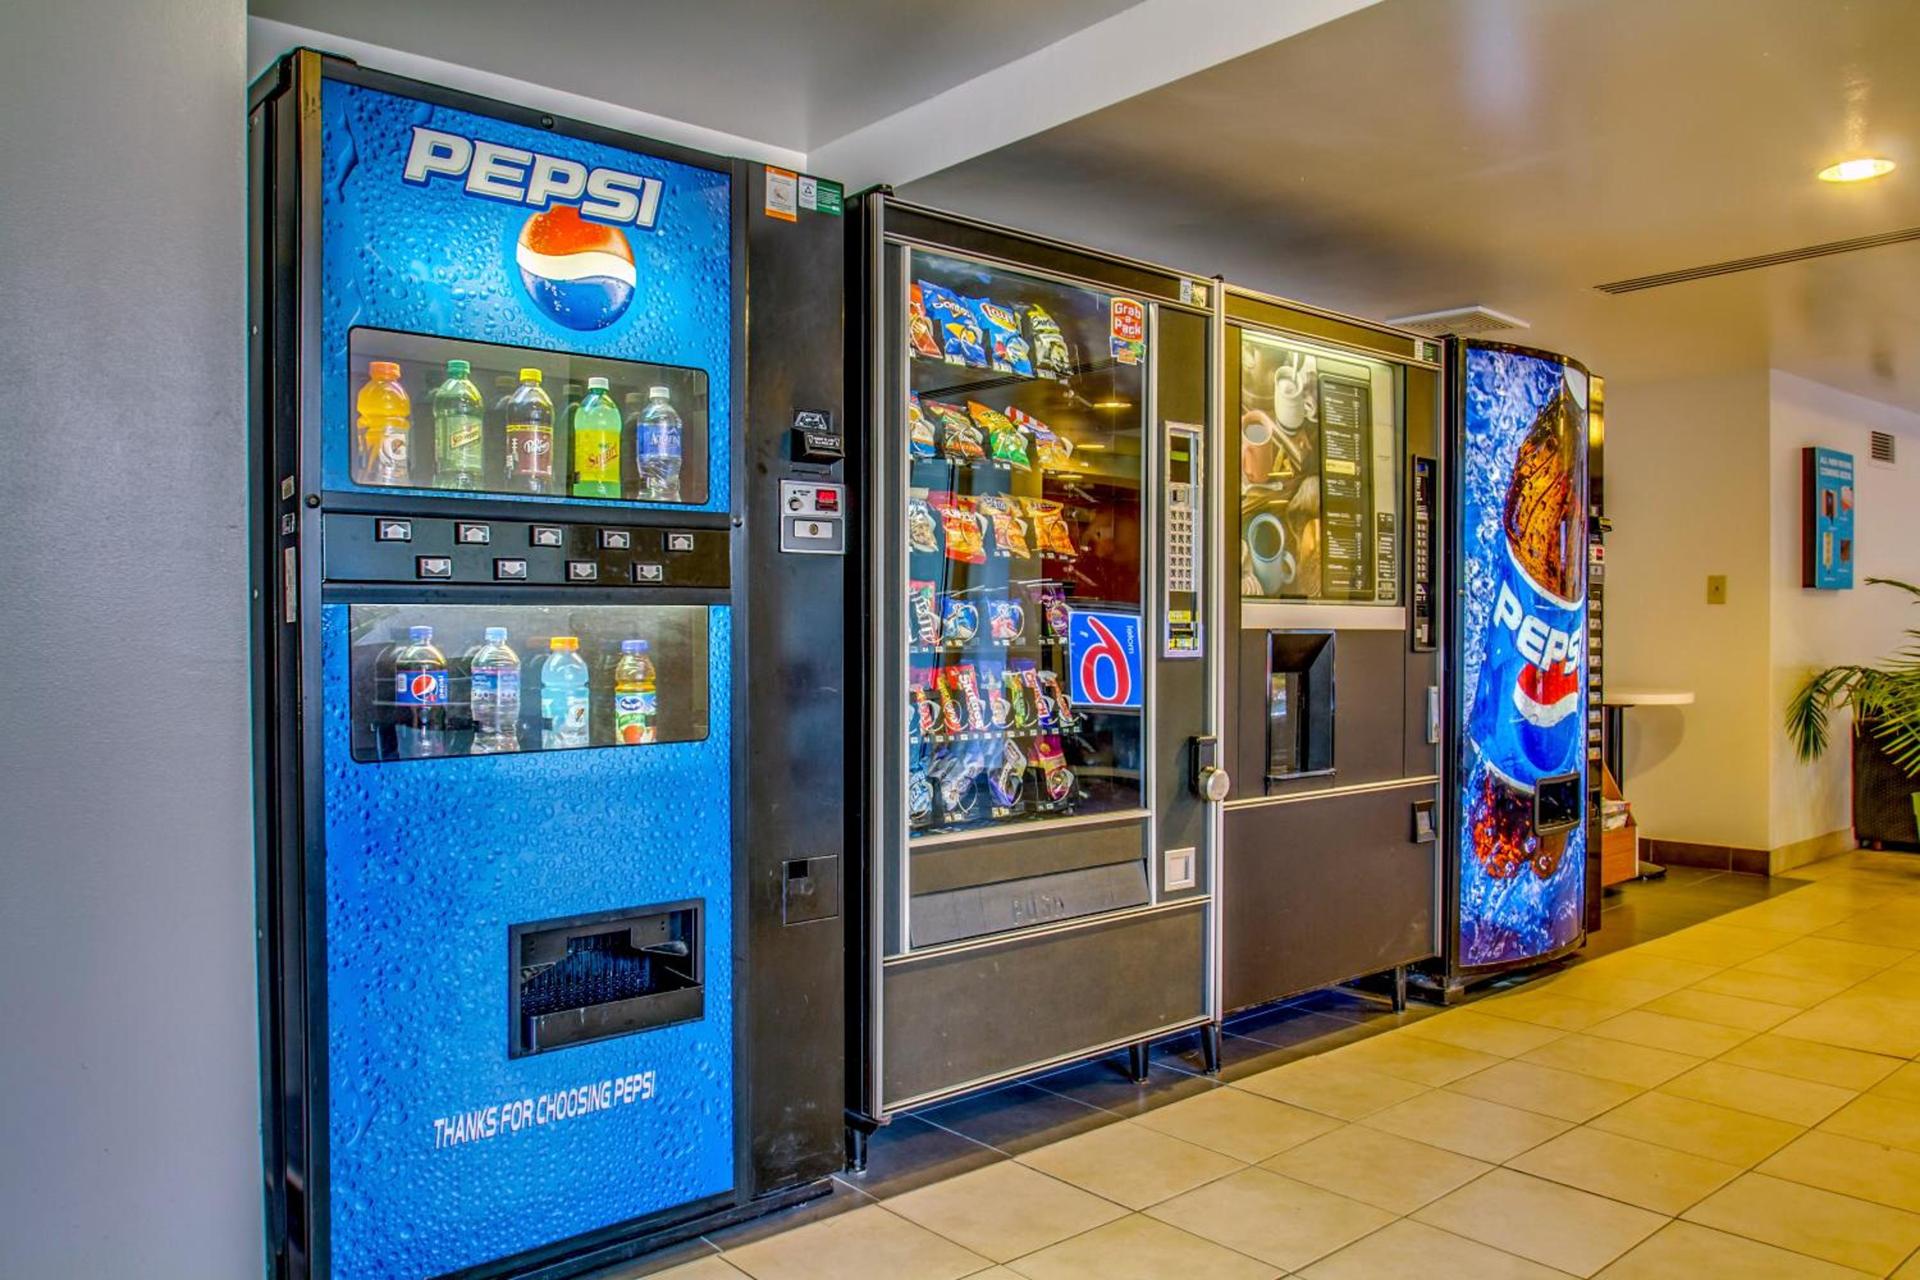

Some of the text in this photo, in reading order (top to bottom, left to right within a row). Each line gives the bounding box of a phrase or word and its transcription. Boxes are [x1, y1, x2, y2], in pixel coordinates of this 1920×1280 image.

[403, 126, 663, 228] PEPSI
[1114, 303, 1142, 319] Grab
[1114, 317, 1142, 335] Pack
[1493, 580, 1581, 675] PEPS
[434, 1070, 656, 1149] THANKS FOR CHOOSING PEPSI
